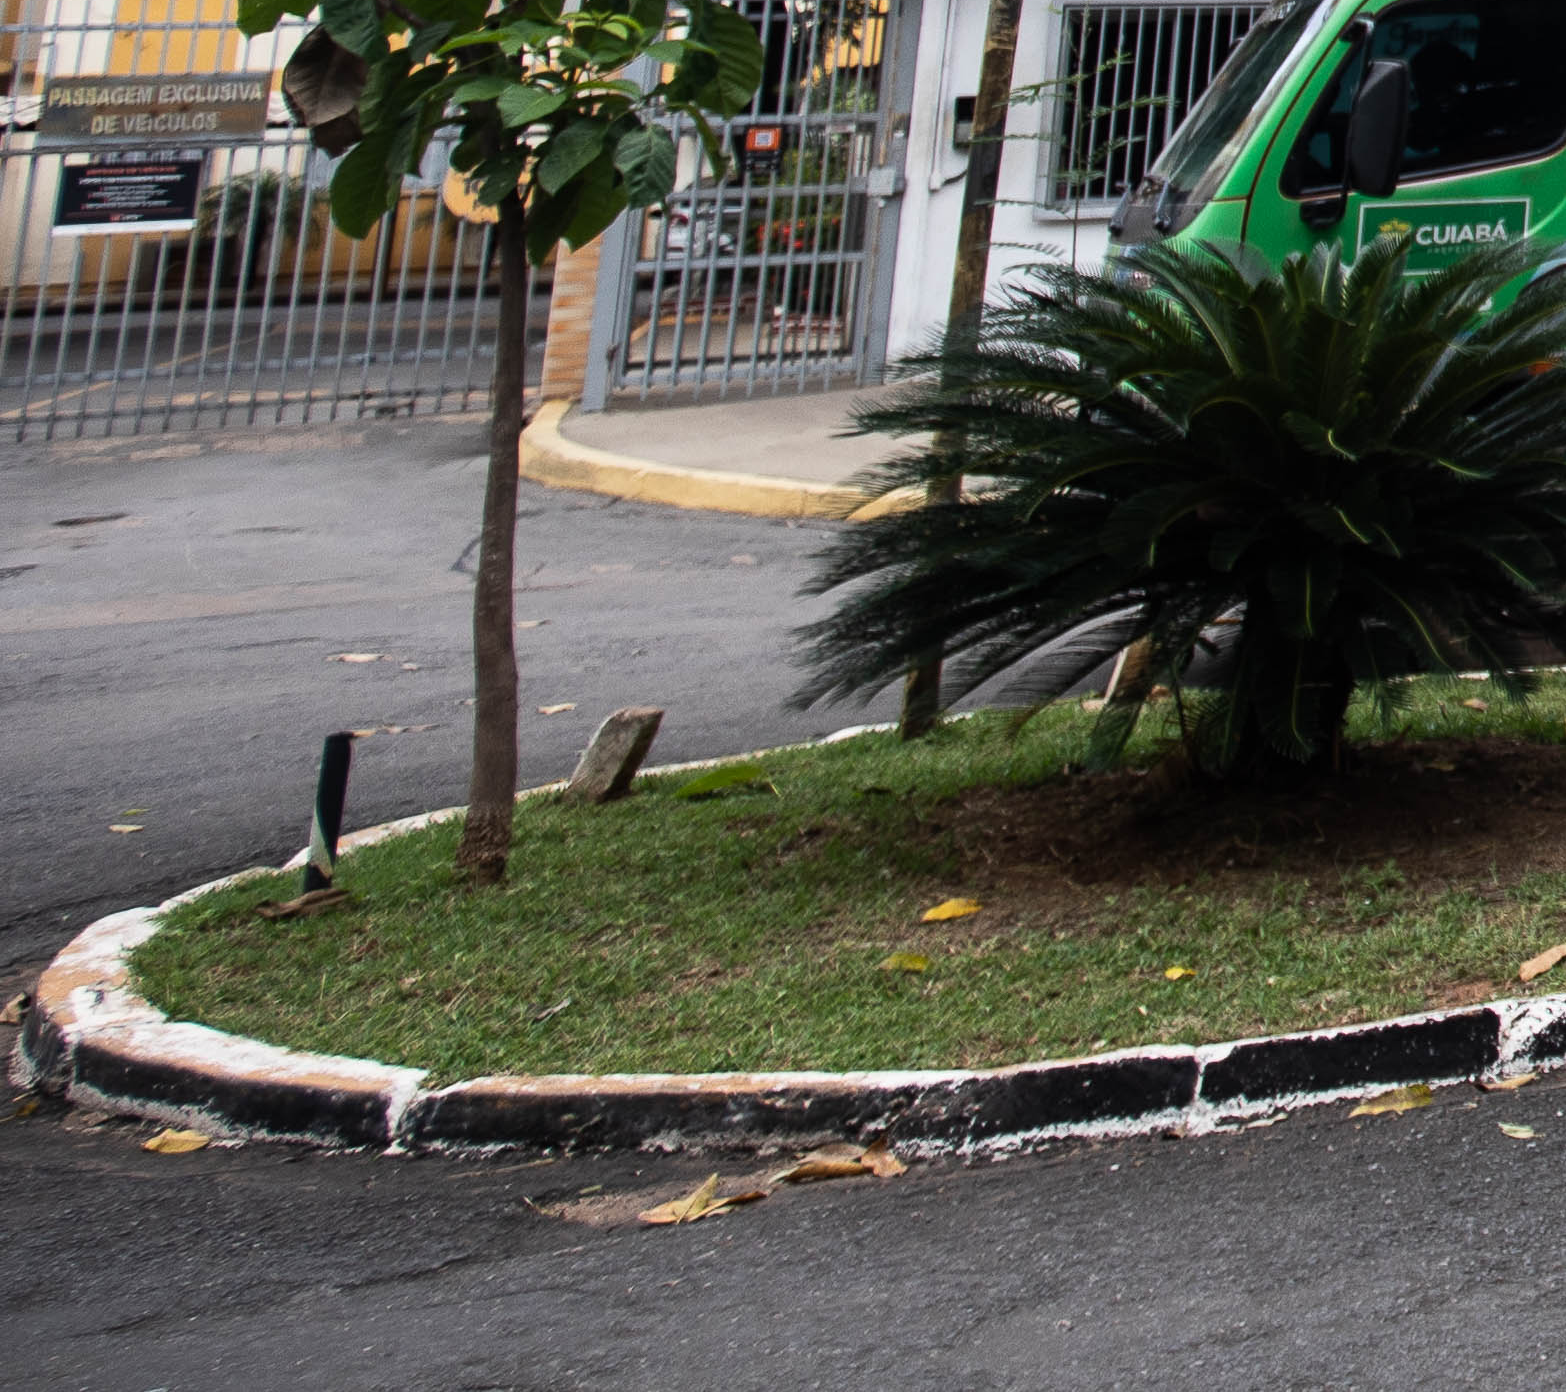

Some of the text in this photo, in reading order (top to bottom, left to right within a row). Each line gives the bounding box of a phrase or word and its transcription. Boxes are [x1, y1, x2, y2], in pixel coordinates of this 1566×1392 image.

[48, 81, 263, 108] PASSAGEM EXCLUSIVA
[91, 113, 120, 135] DE
[1416, 218, 1508, 246] CUIABÁ
